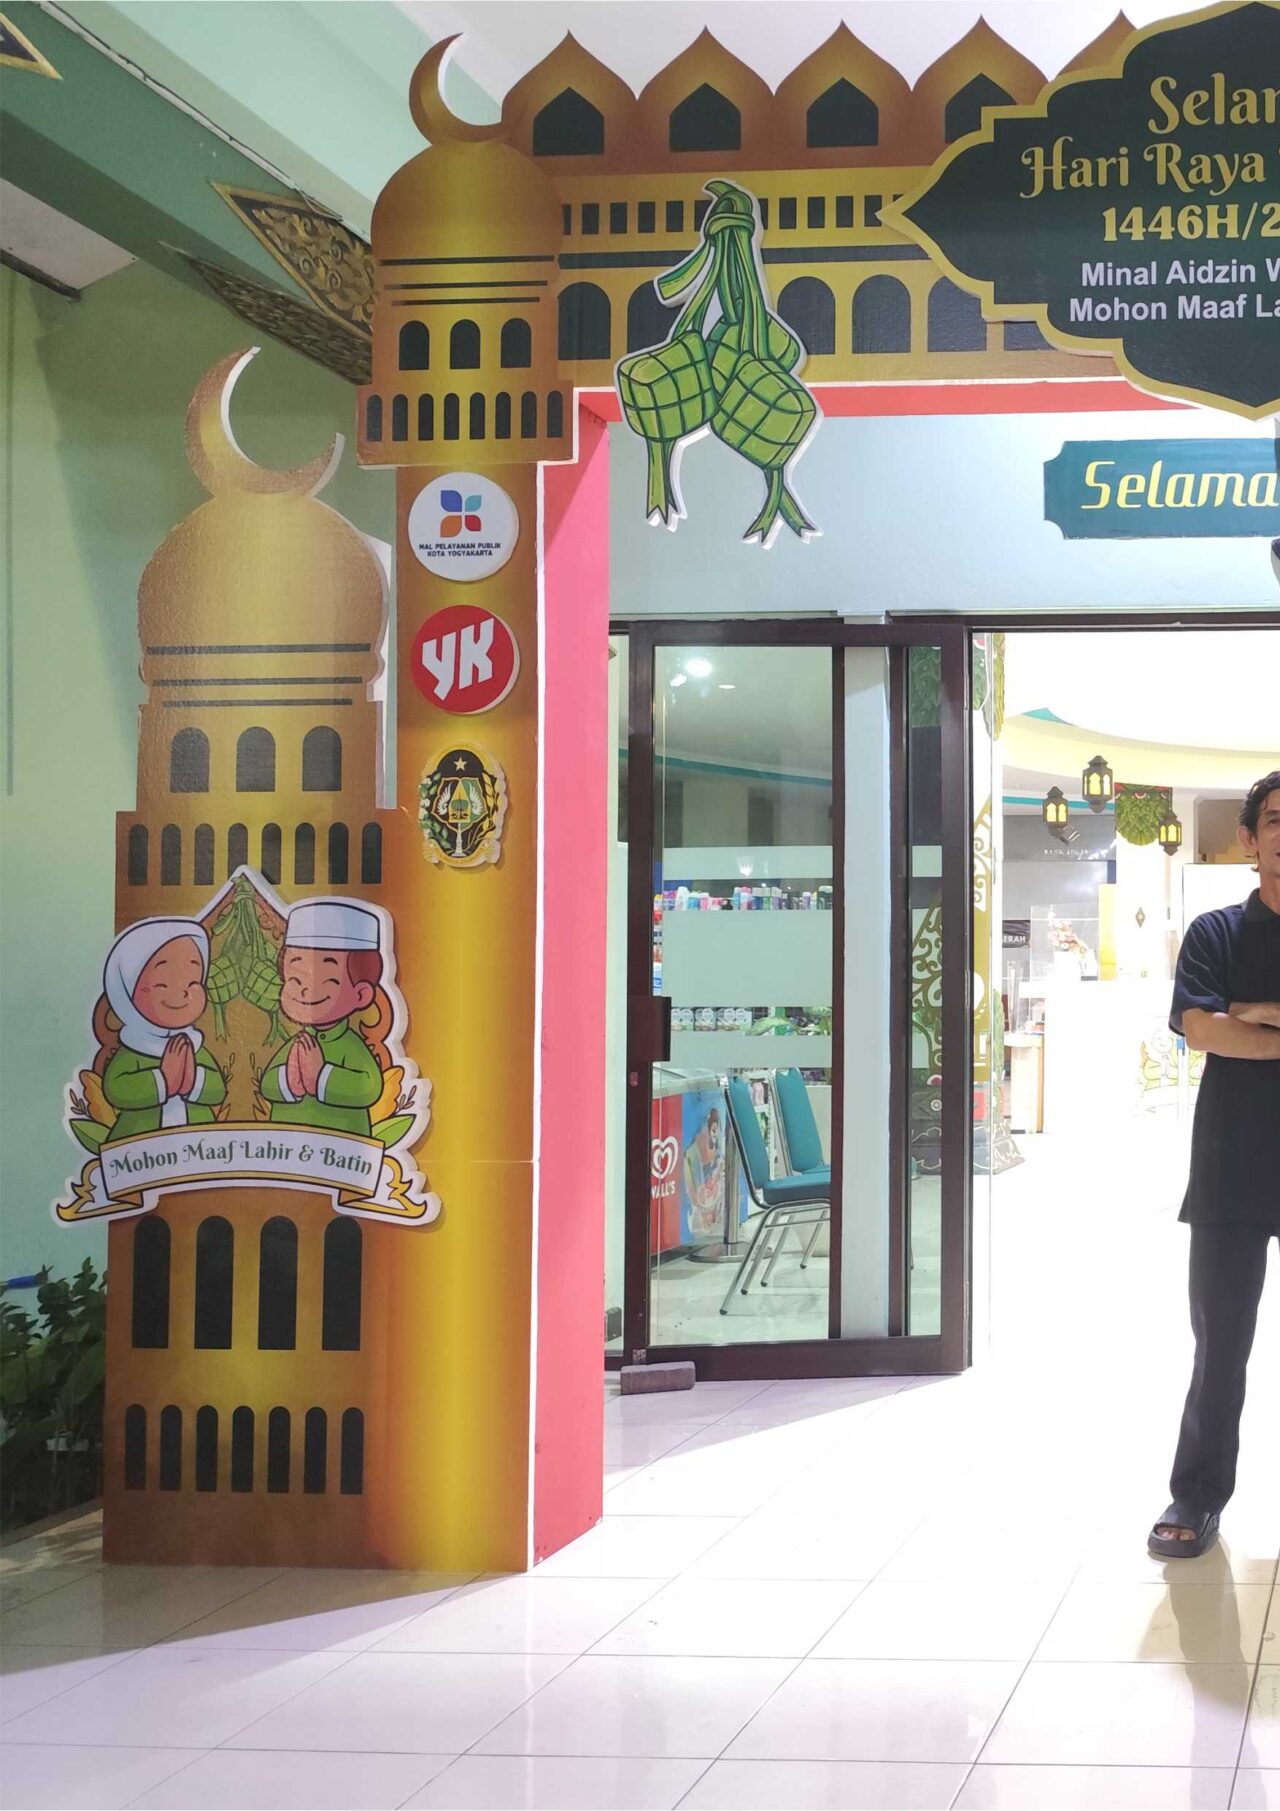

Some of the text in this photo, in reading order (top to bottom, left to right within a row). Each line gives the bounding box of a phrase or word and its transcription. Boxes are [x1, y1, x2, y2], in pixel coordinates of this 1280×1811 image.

[1019, 135, 1129, 198] Hari
[1143, 142, 1267, 196] Raya
[1081, 260, 1157, 287] Minal
[1165, 258, 1256, 285] Aidzin
[1070, 297, 1167, 322] Mohon
[1177, 293, 1248, 320] Maaf
[447, 549, 493, 557] YOGYAKARTA
[1001, 935, 1026, 943] ERAH
[109, 1138, 374, 1179] Mohon Maaf Lahir & Batin
